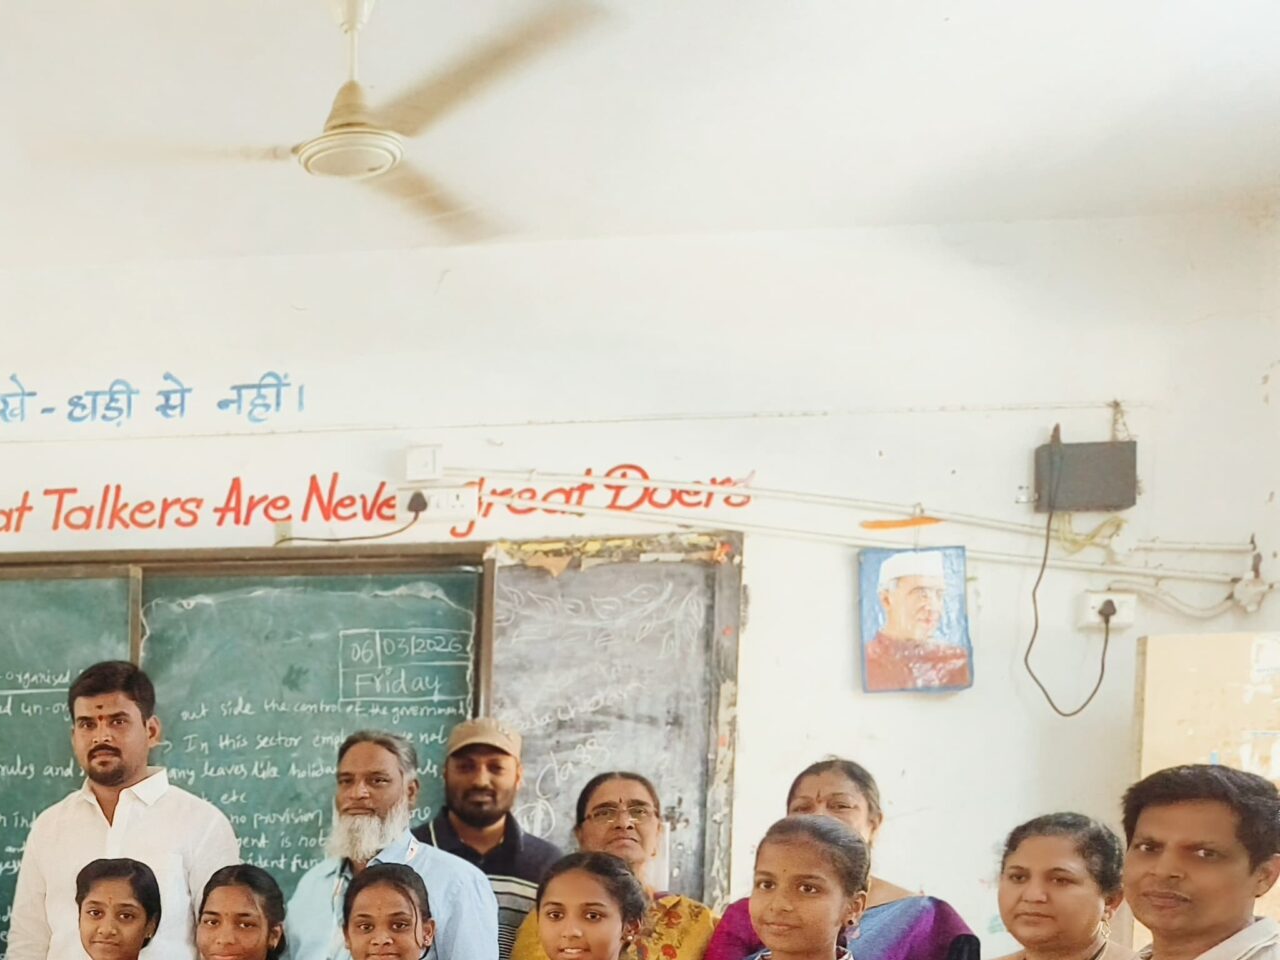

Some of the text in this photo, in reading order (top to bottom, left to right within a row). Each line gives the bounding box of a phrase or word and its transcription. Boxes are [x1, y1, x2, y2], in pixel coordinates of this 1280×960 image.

[155, 371, 193, 419] से
[44, 483, 203, 535] Talkers
[213, 477, 292, 529] Are
[302, 472, 398, 526] Neve
[355, 667, 442, 702] Friday
